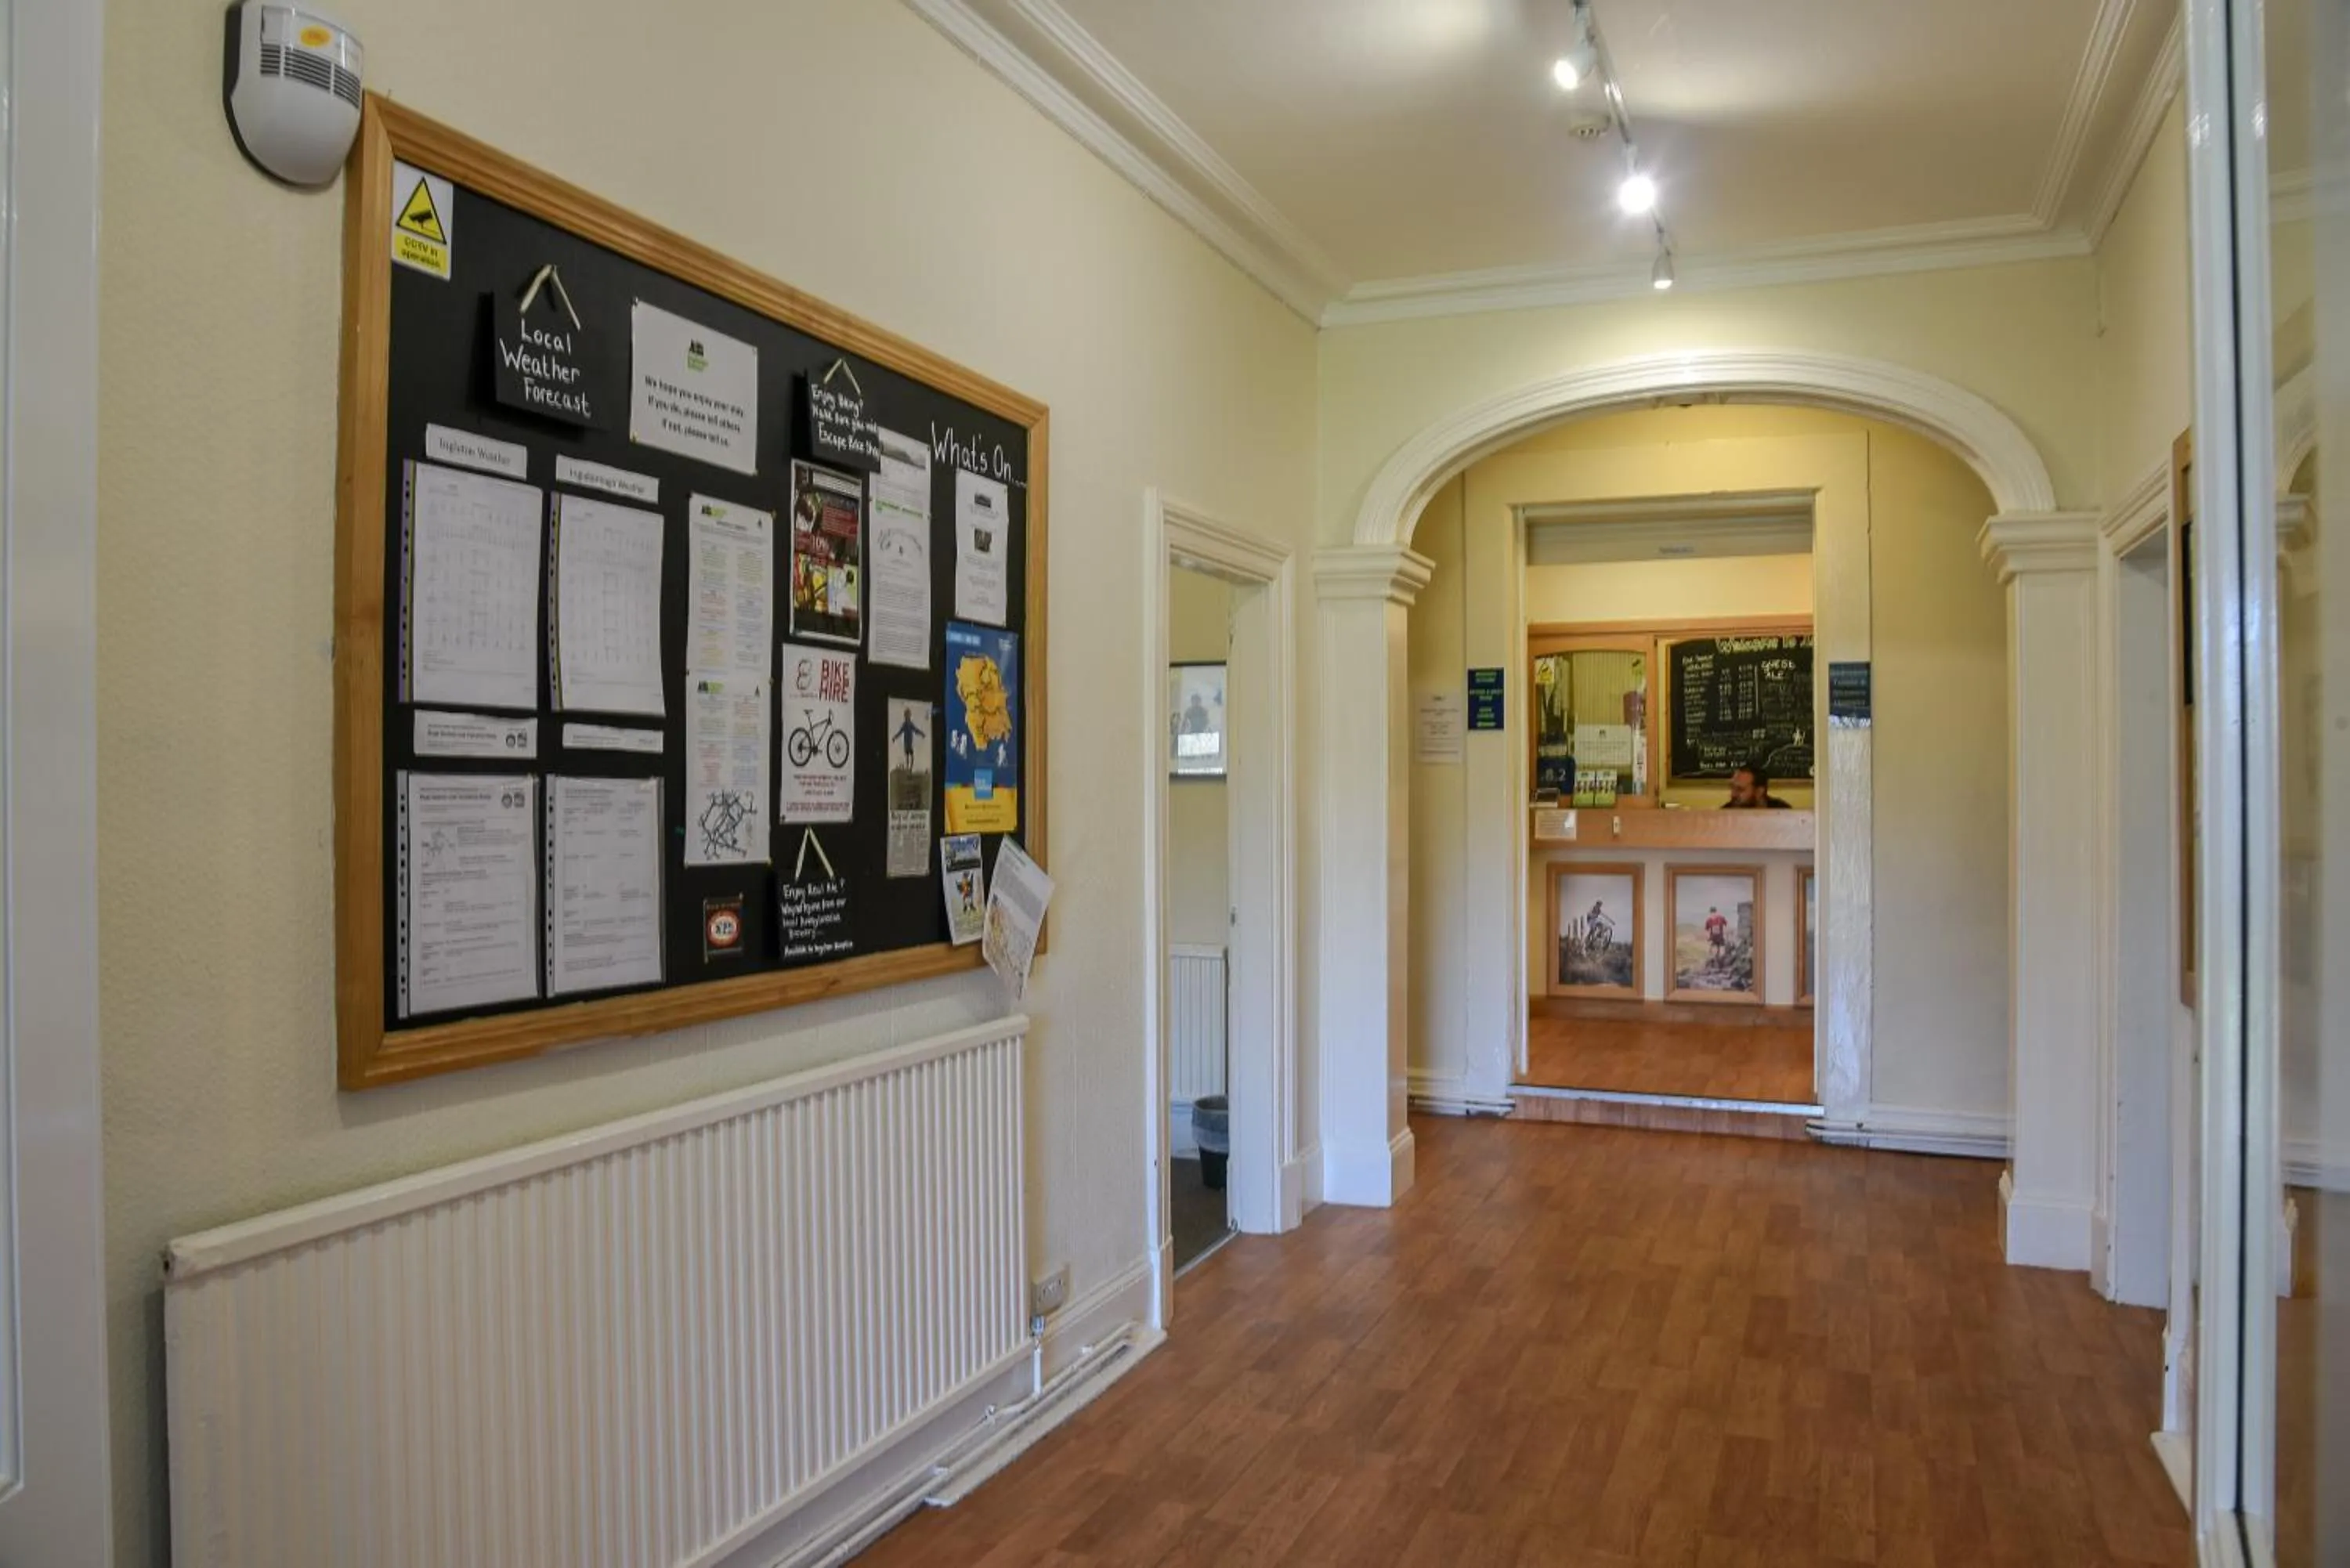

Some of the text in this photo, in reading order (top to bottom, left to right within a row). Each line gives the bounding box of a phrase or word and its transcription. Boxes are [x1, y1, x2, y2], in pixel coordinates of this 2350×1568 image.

[520, 316, 572, 356] Local
[499, 338, 580, 385] Weather
[523, 376, 592, 420] Forecast
[811, 383, 836, 413] Enjoy
[439, 437, 475, 457] Ingleton
[817, 421, 848, 453] Escape
[931, 420, 989, 475] What's
[821, 659, 850, 682] BIKE
[819, 677, 850, 703] HIRE
